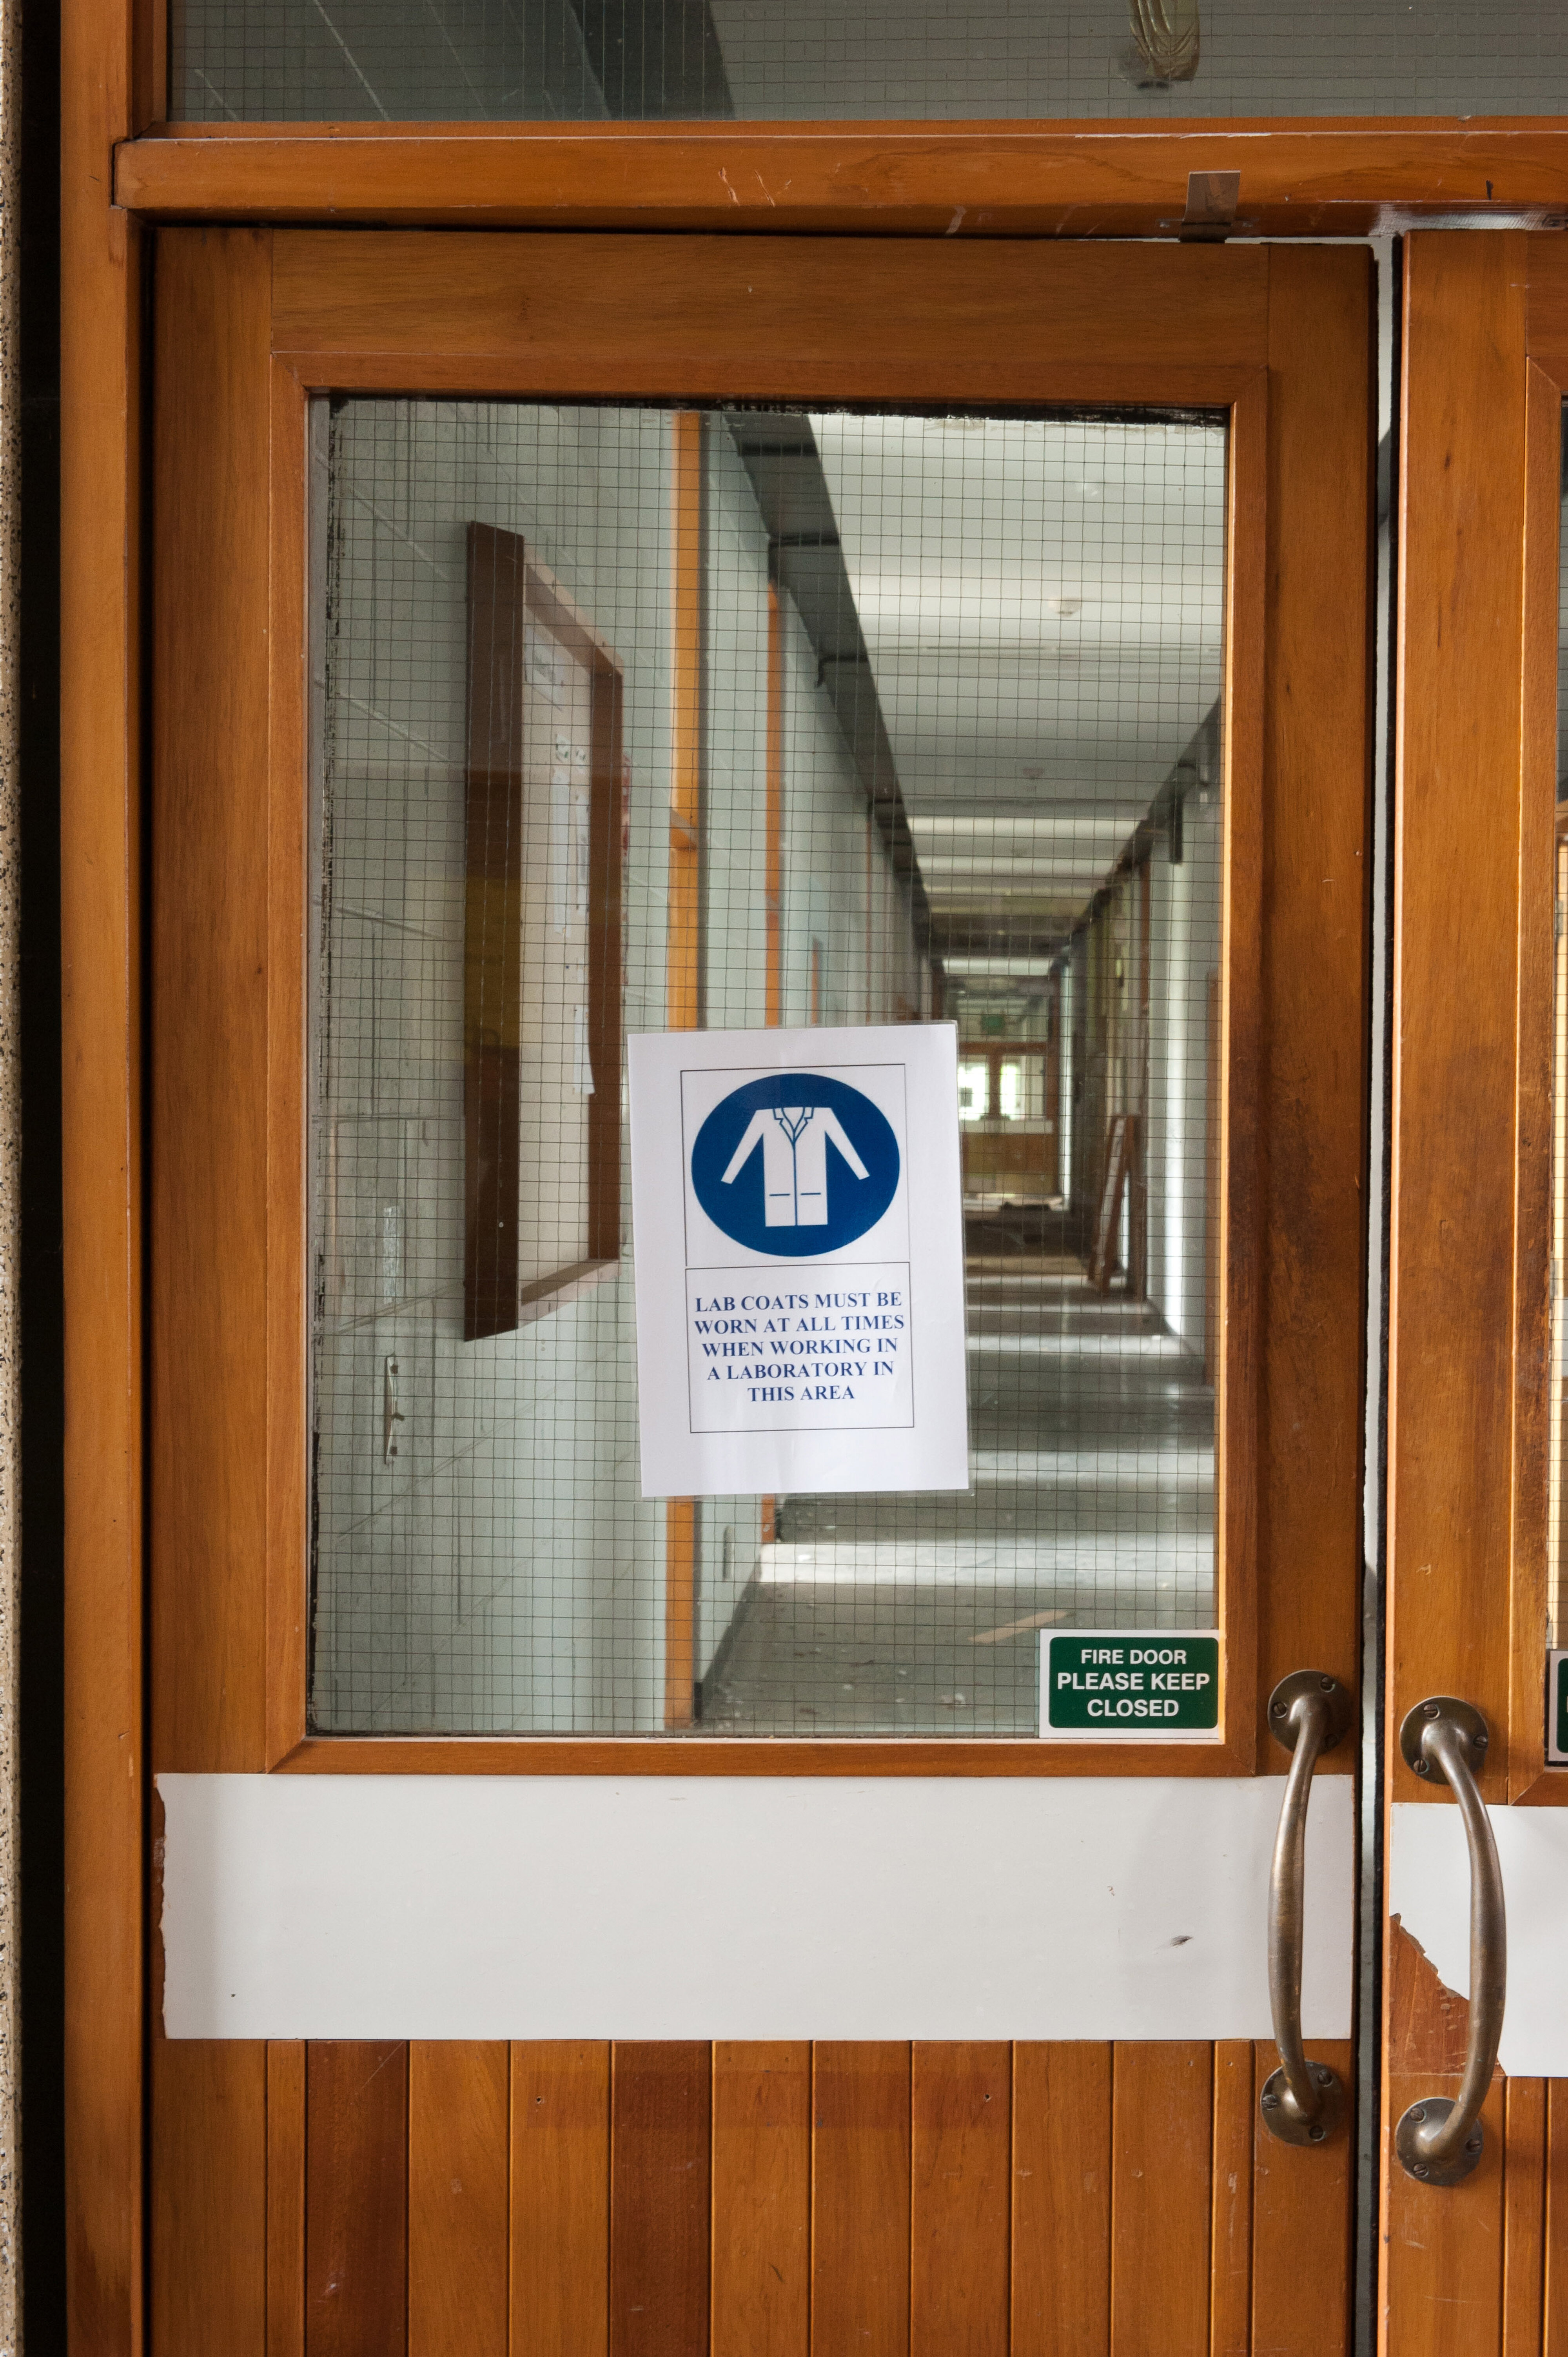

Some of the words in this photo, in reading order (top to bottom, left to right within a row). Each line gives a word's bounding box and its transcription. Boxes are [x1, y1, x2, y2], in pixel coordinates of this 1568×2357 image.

[695, 1297, 736, 1312] LAB
[741, 1294, 809, 1310] COATS
[815, 1293, 870, 1308] MUST
[877, 1292, 902, 1306] BE
[694, 1319, 757, 1334] WORN
[763, 1318, 790, 1333] AT
[796, 1317, 835, 1332] ALL
[841, 1315, 904, 1330] TIMES
[702, 1341, 764, 1357] WHEN
[769, 1339, 870, 1355] WORKING
[878, 1338, 897, 1352] IN
[707, 1366, 720, 1380] A
[727, 1362, 867, 1379] LABORATORY
[874, 1361, 893, 1375] IN
[747, 1386, 795, 1402] THIS
[800, 1385, 855, 1400] AREA
[1081, 1649, 1124, 1664] FIRE
[1130, 1649, 1186, 1665] DOOR
[1058, 1672, 1144, 1690] PLEASE
[1151, 1673, 1210, 1690] KEEP
[1087, 1699, 1179, 1717] CLOSED
